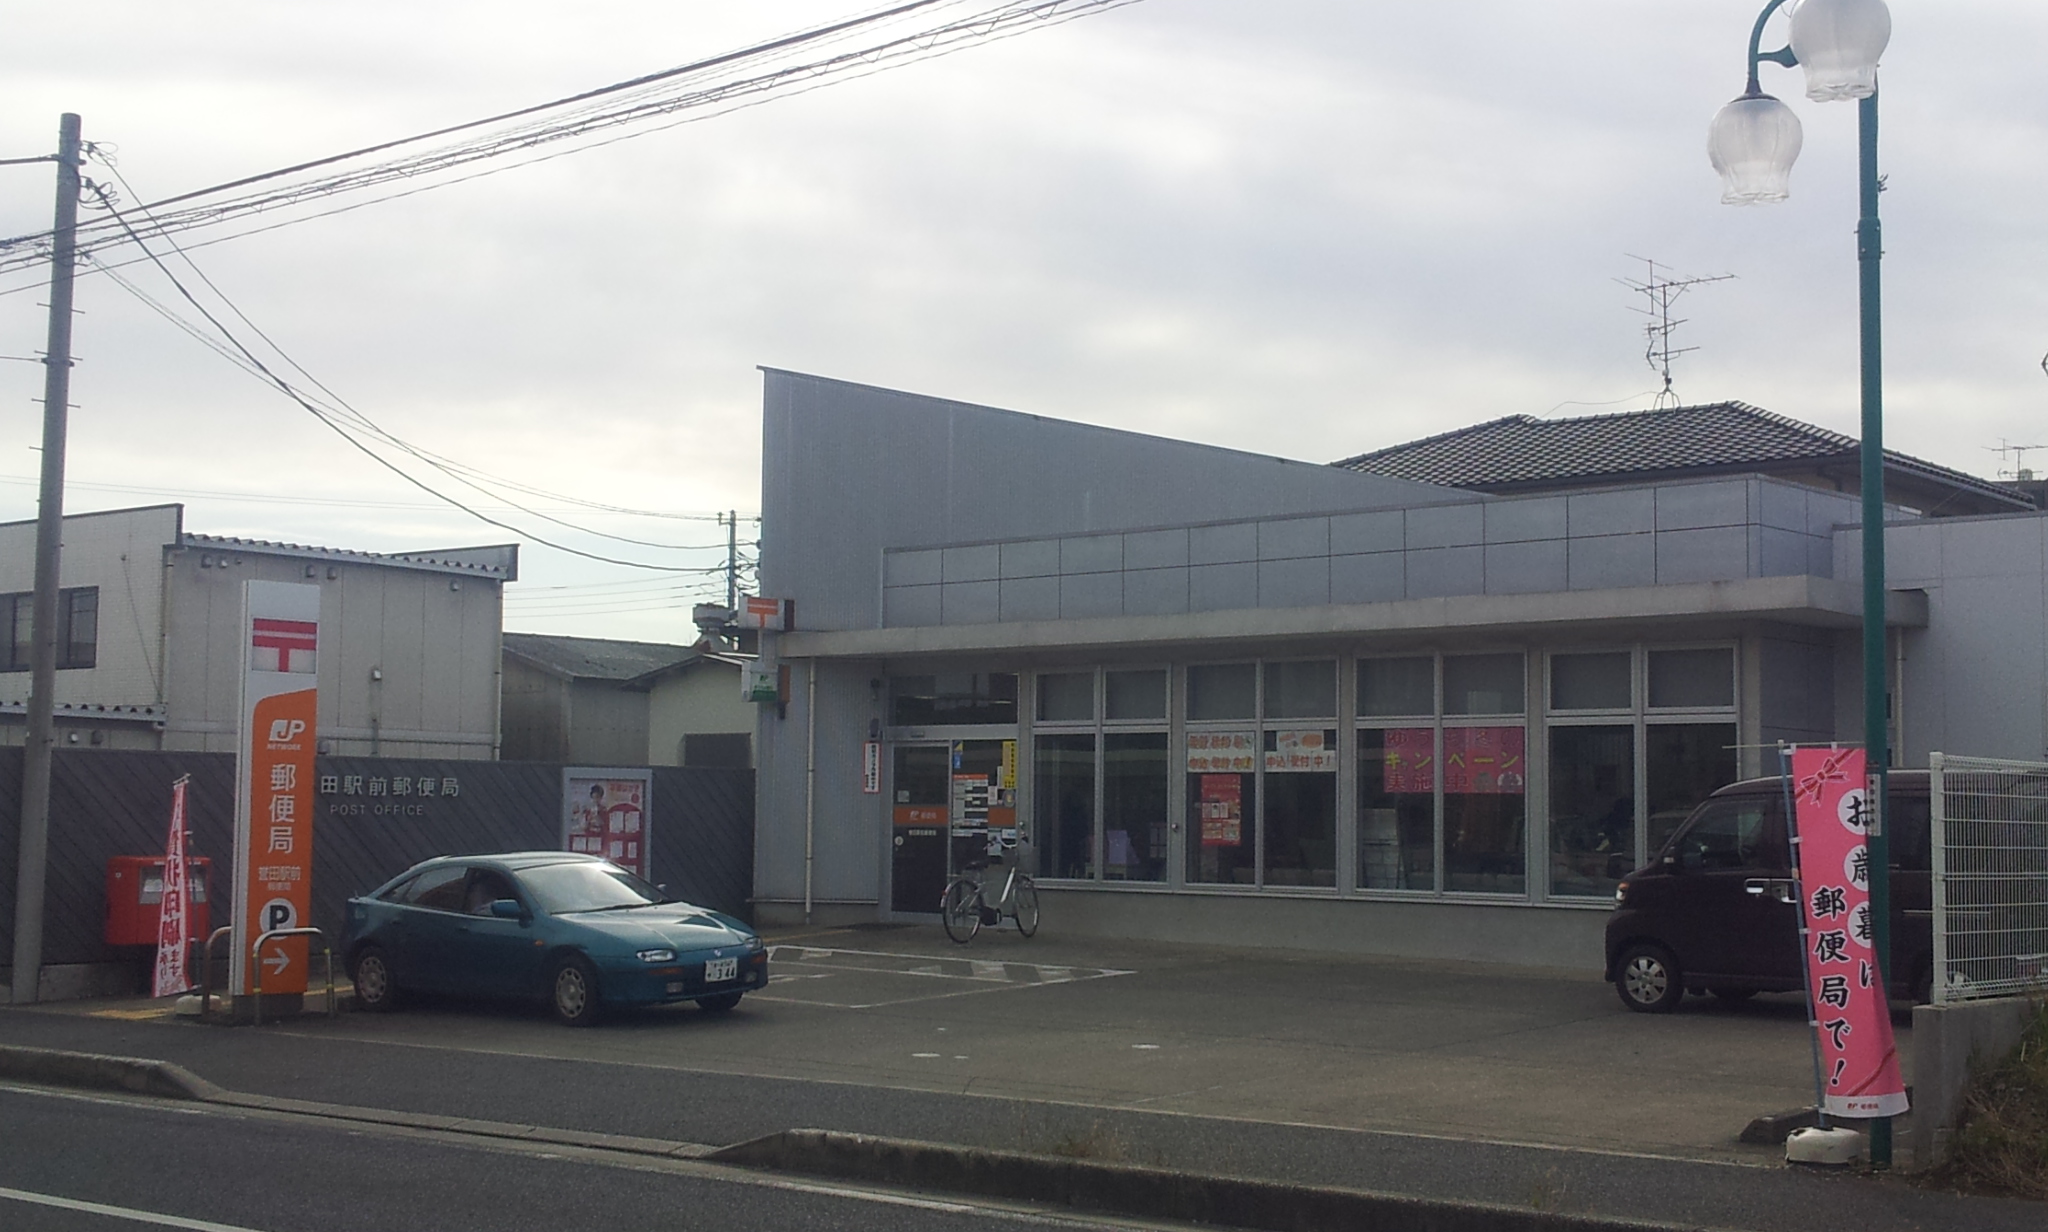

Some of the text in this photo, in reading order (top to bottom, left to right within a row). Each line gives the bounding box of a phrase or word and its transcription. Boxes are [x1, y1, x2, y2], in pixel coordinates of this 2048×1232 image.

[268, 719, 306, 742] JP
[1385, 750, 1520, 770] キャンペーン
[320, 775, 460, 797] 田駅前郵便局
[267, 763, 297, 855] 郵便局
[330, 804, 424, 816] POST OFFICE
[269, 904, 291, 933] P
[1811, 885, 1851, 1086] 郵便局で！
